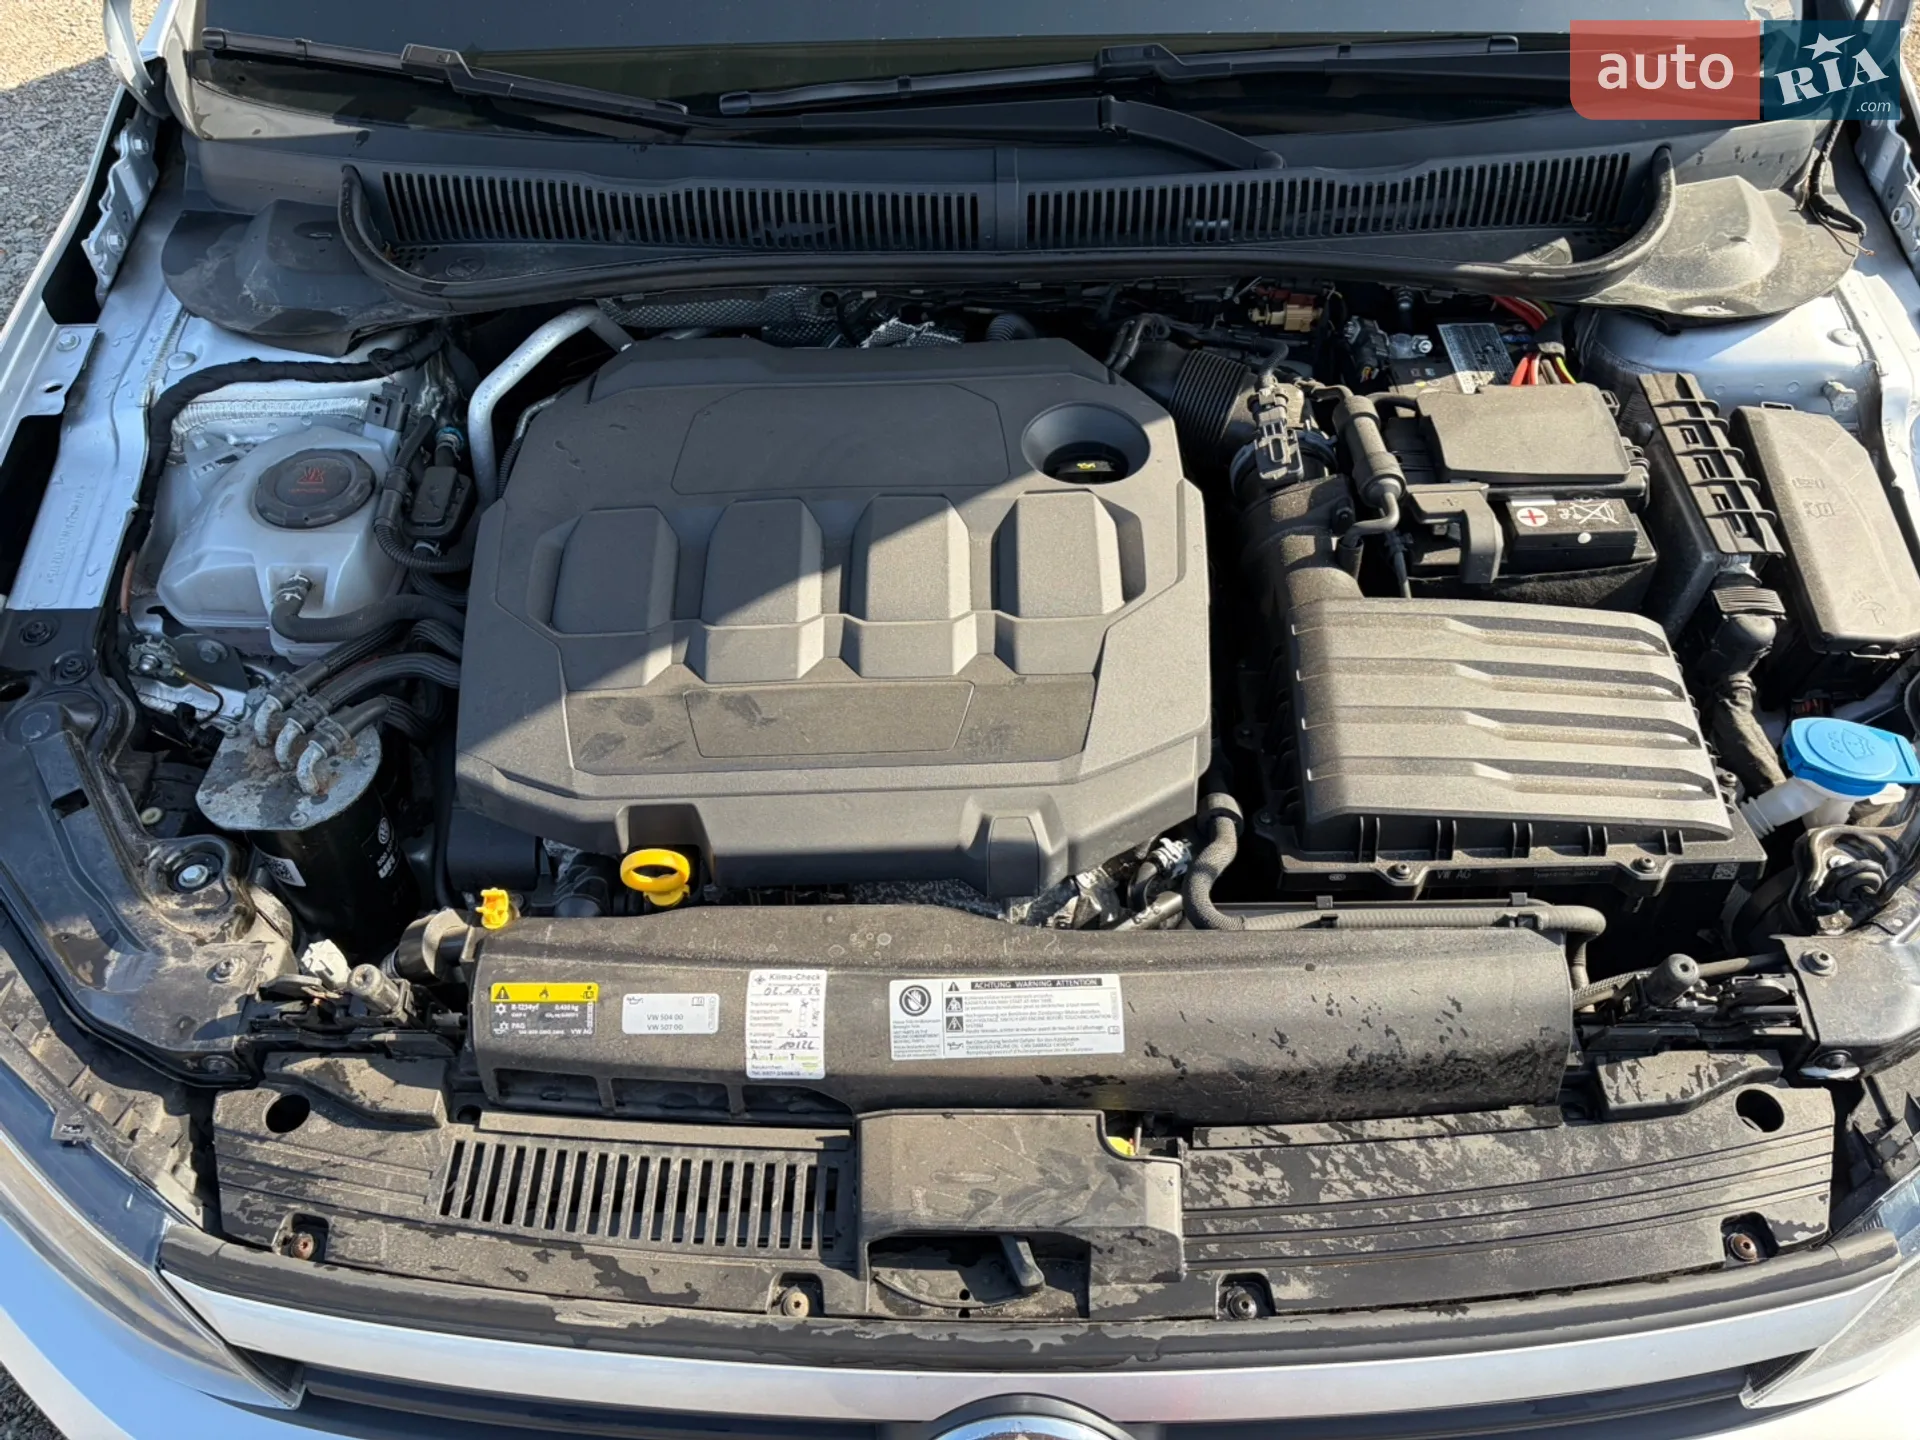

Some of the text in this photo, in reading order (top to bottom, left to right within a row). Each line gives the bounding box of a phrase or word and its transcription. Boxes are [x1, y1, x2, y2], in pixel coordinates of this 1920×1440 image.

[769, 973, 820, 981] Klima-Check
[974, 979, 1097, 989] ACHTUNG WARNING ATTENTION
[646, 1013, 684, 1021] VW 504 00
[646, 1023, 684, 1031] VW 507 00
